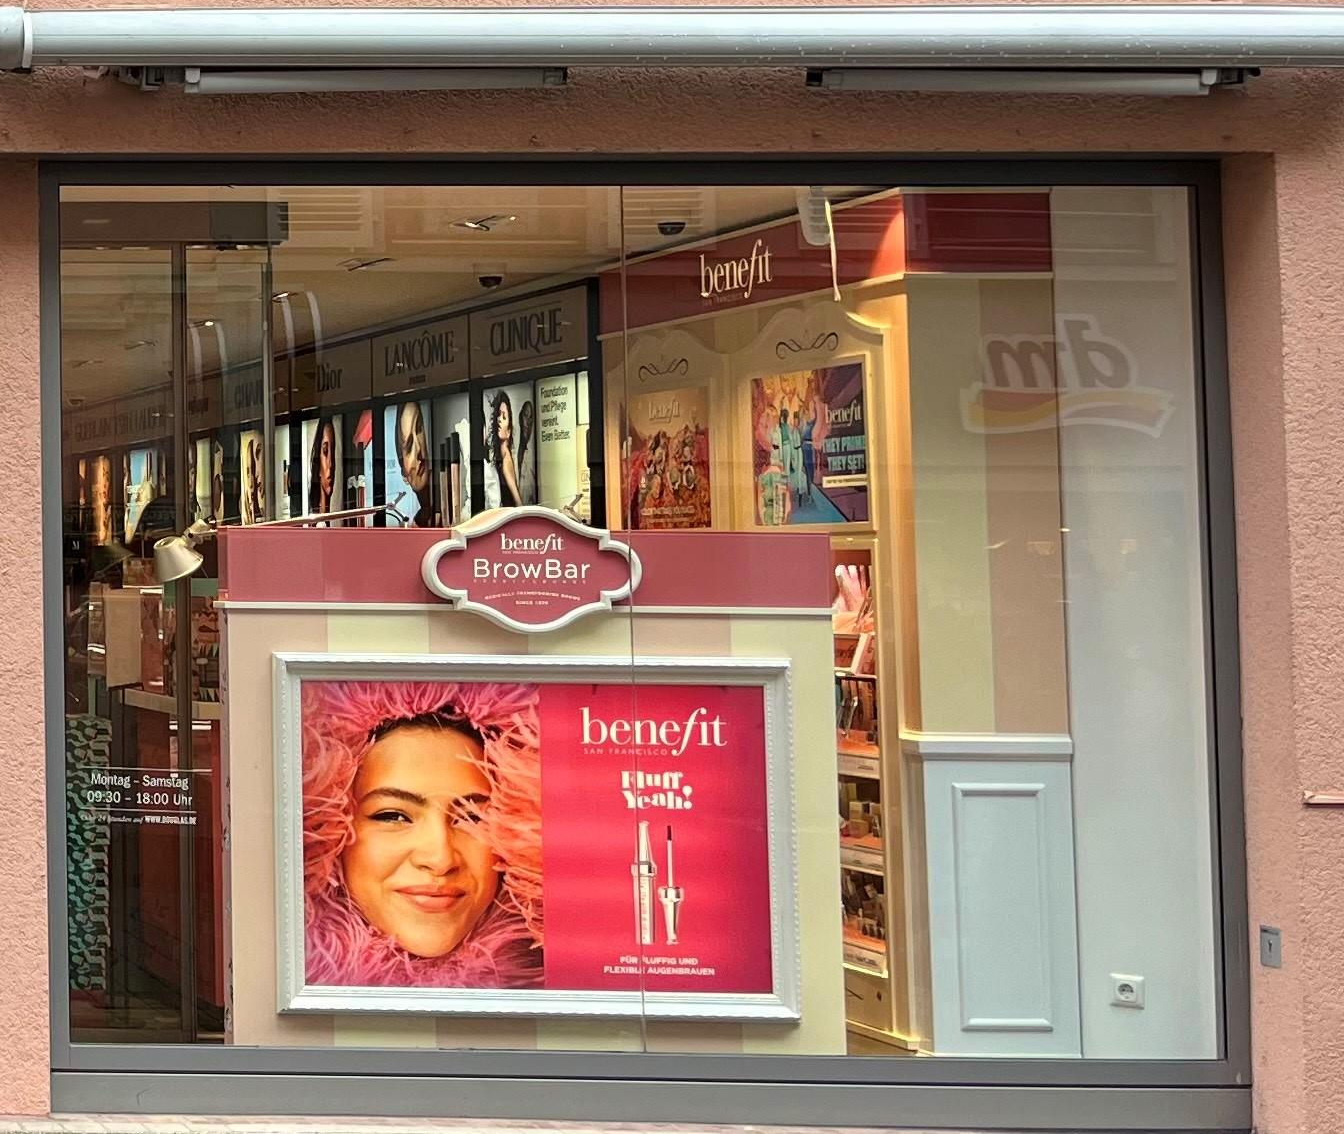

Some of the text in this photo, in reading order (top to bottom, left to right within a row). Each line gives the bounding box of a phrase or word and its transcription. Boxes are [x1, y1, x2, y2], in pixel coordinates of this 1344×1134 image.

[699, 239, 772, 299] benefit
[490, 308, 562, 354] CLINIQUE
[385, 330, 454, 376] LANCÔME
[317, 363, 343, 392] Dior
[501, 533, 564, 554] benefit
[473, 558, 591, 579] BrowBar
[579, 706, 728, 756] benefit
[583, 747, 668, 755] SAN FRANCISCO
[91, 773, 131, 788] Montag
[142, 774, 189, 790] Samstag
[621, 770, 683, 789] Fluff
[87, 790, 121, 804] 09:30
[136, 792, 169, 805] 18:00
[173, 793, 193, 805] Uhr
[621, 785, 693, 809] Yeah!
[619, 955, 638, 965] FÜR
[678, 957, 699, 965] UND
[647, 967, 715, 976] AUGENBRAUEN
